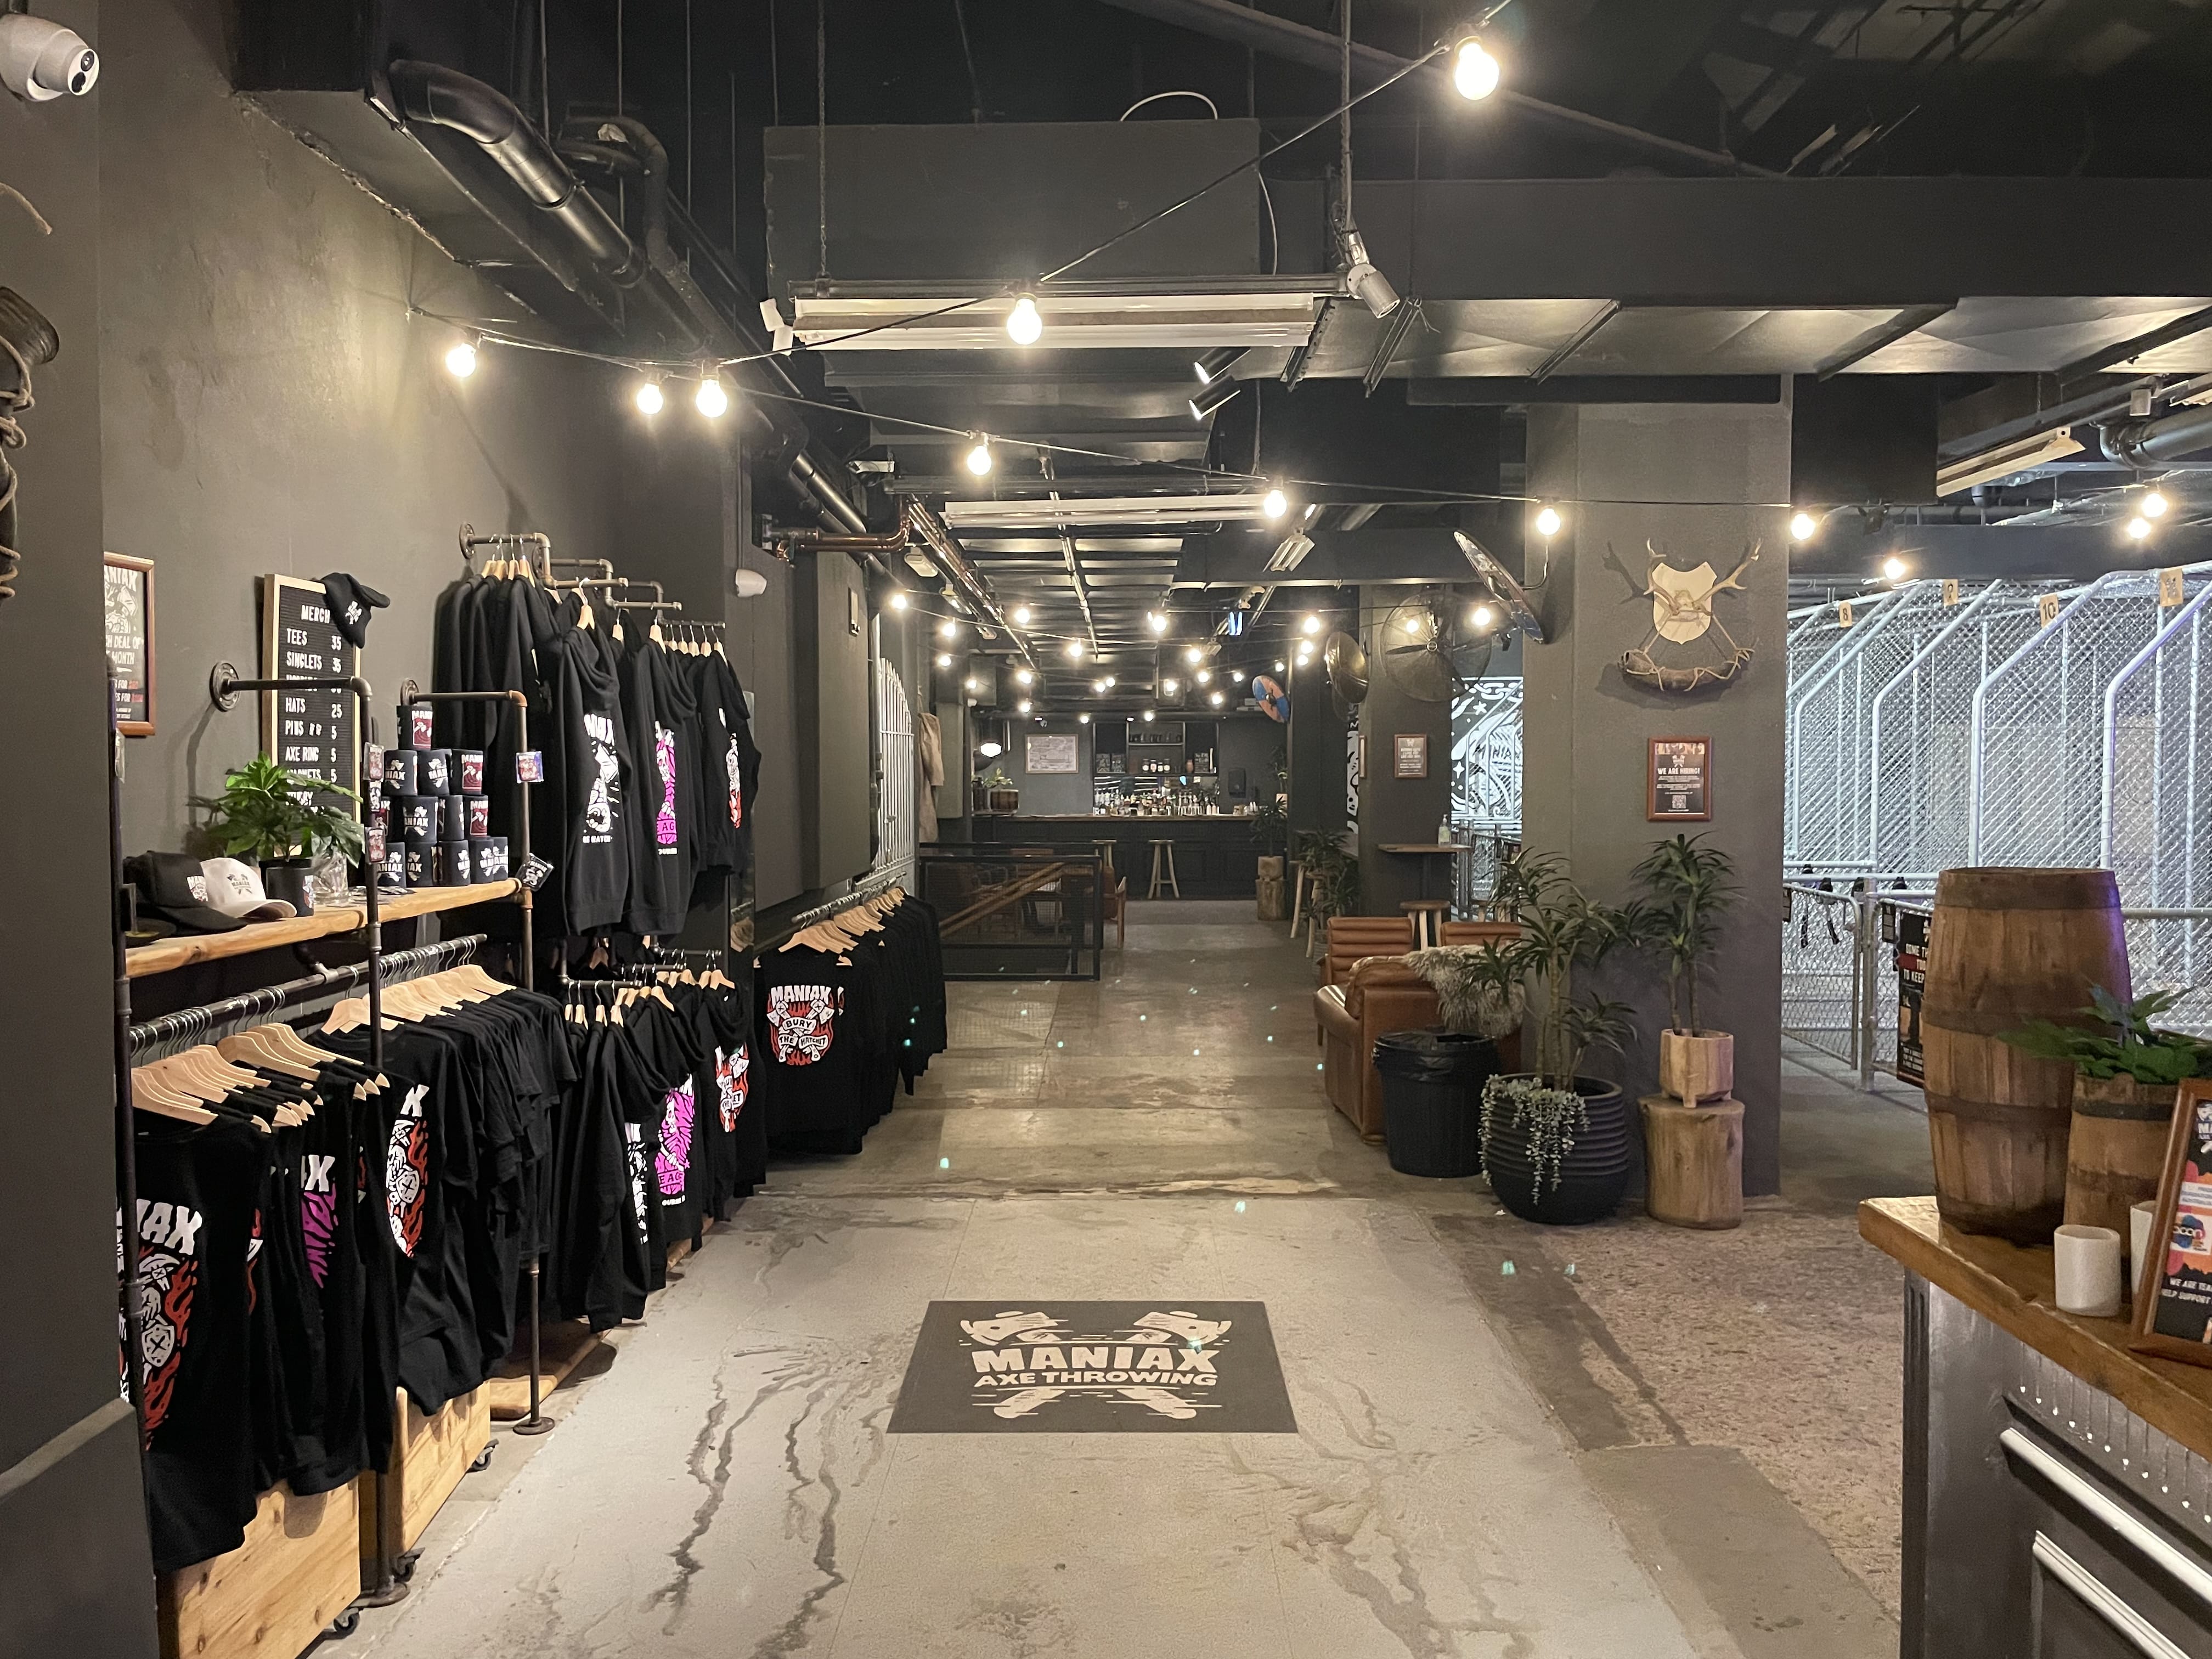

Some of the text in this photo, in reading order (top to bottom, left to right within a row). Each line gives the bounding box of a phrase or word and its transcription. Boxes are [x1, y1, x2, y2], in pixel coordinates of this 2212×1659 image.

[302, 605, 330, 624] MERCH
[1843, 608, 1849, 621] 8
[2043, 602, 2056, 620] 10
[114, 635, 131, 648] DEAL
[286, 628, 342, 651] TEES 35
[286, 651, 342, 673] SINGLETS 35
[285, 697, 342, 718] HATS 25
[285, 720, 337, 740] PINS 5
[285, 746, 300, 761] AXE
[331, 748, 337, 763] 5
[331, 769, 337, 783] 5
[771, 985, 832, 1008] MANIAX
[786, 1019, 812, 1029] BURY
[800, 1037, 826, 1047] HATCHET
[2170, 1277, 2182, 1286] WE
[972, 1346, 1220, 1373] MANIAX
[974, 1370, 1218, 1387] AXE THROWING
